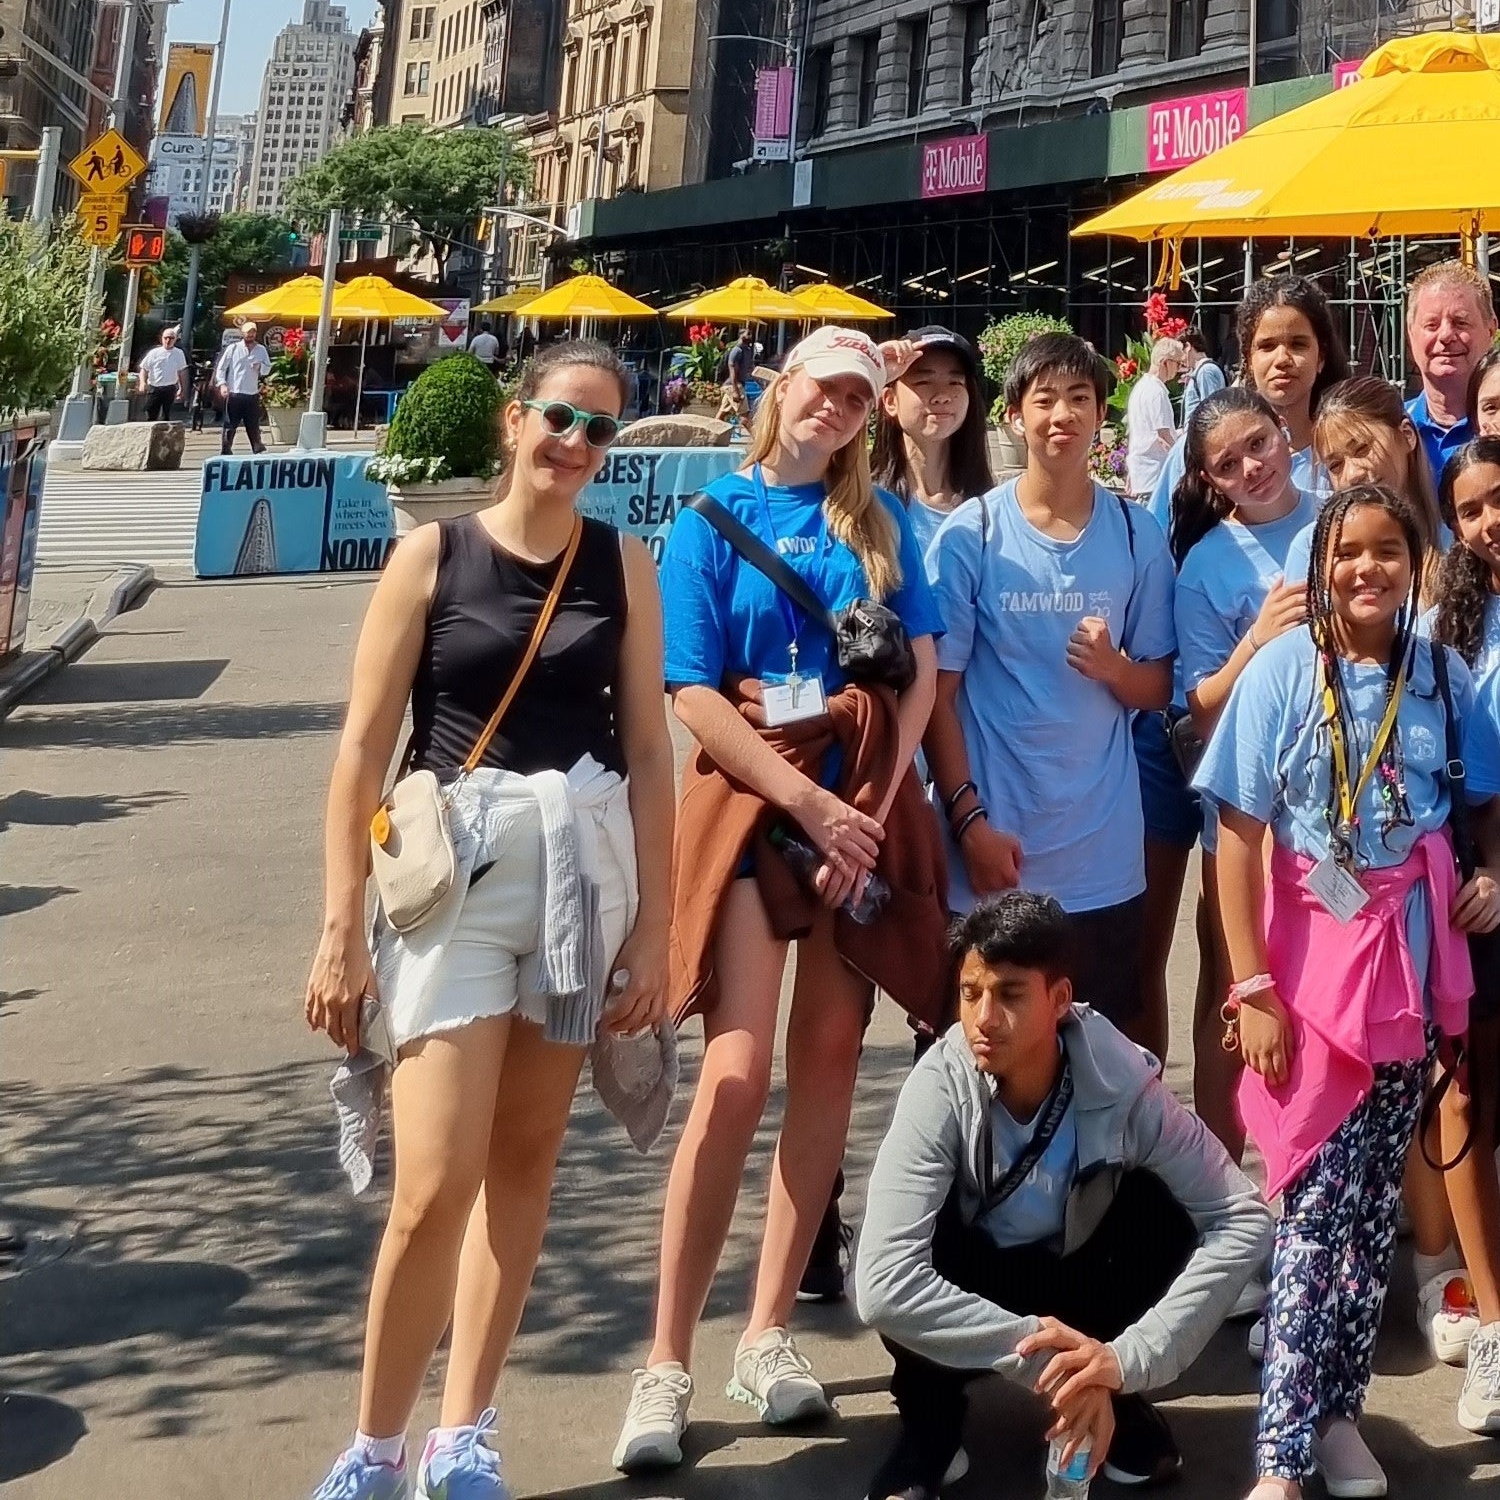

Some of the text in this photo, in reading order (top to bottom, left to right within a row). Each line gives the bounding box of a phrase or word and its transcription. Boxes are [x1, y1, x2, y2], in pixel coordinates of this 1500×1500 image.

[95, 215, 108, 231] 5
[205, 458, 336, 492] FLATIRON
[320, 537, 398, 571] NOMA
[1000, 591, 1084, 612] TAMWOOD
